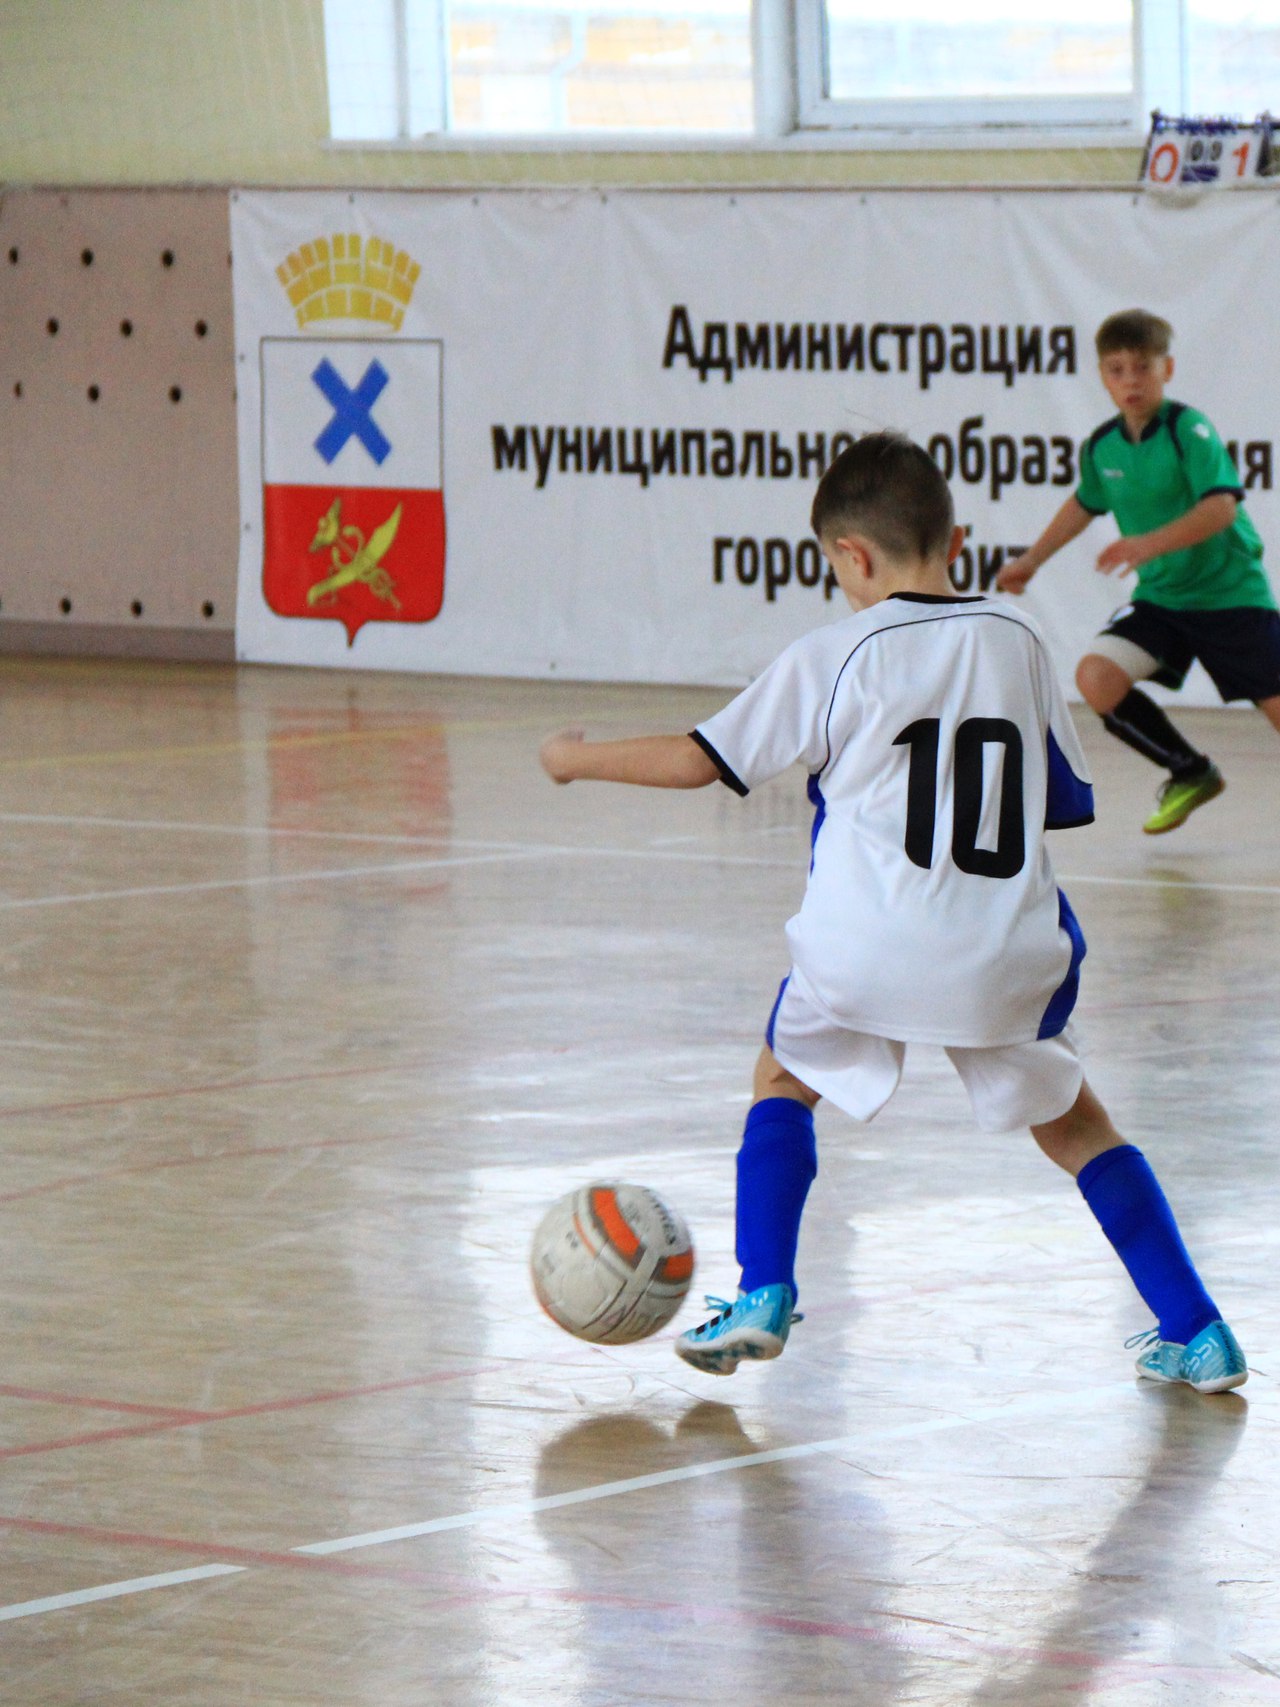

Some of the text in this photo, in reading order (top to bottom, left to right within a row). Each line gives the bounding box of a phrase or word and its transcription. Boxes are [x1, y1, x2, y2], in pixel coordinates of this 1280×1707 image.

[1149, 142, 1180, 183] 0
[1232, 141, 1250, 177] 1
[662, 303, 1078, 390] Администрация
[891, 716, 1026, 880] 10
